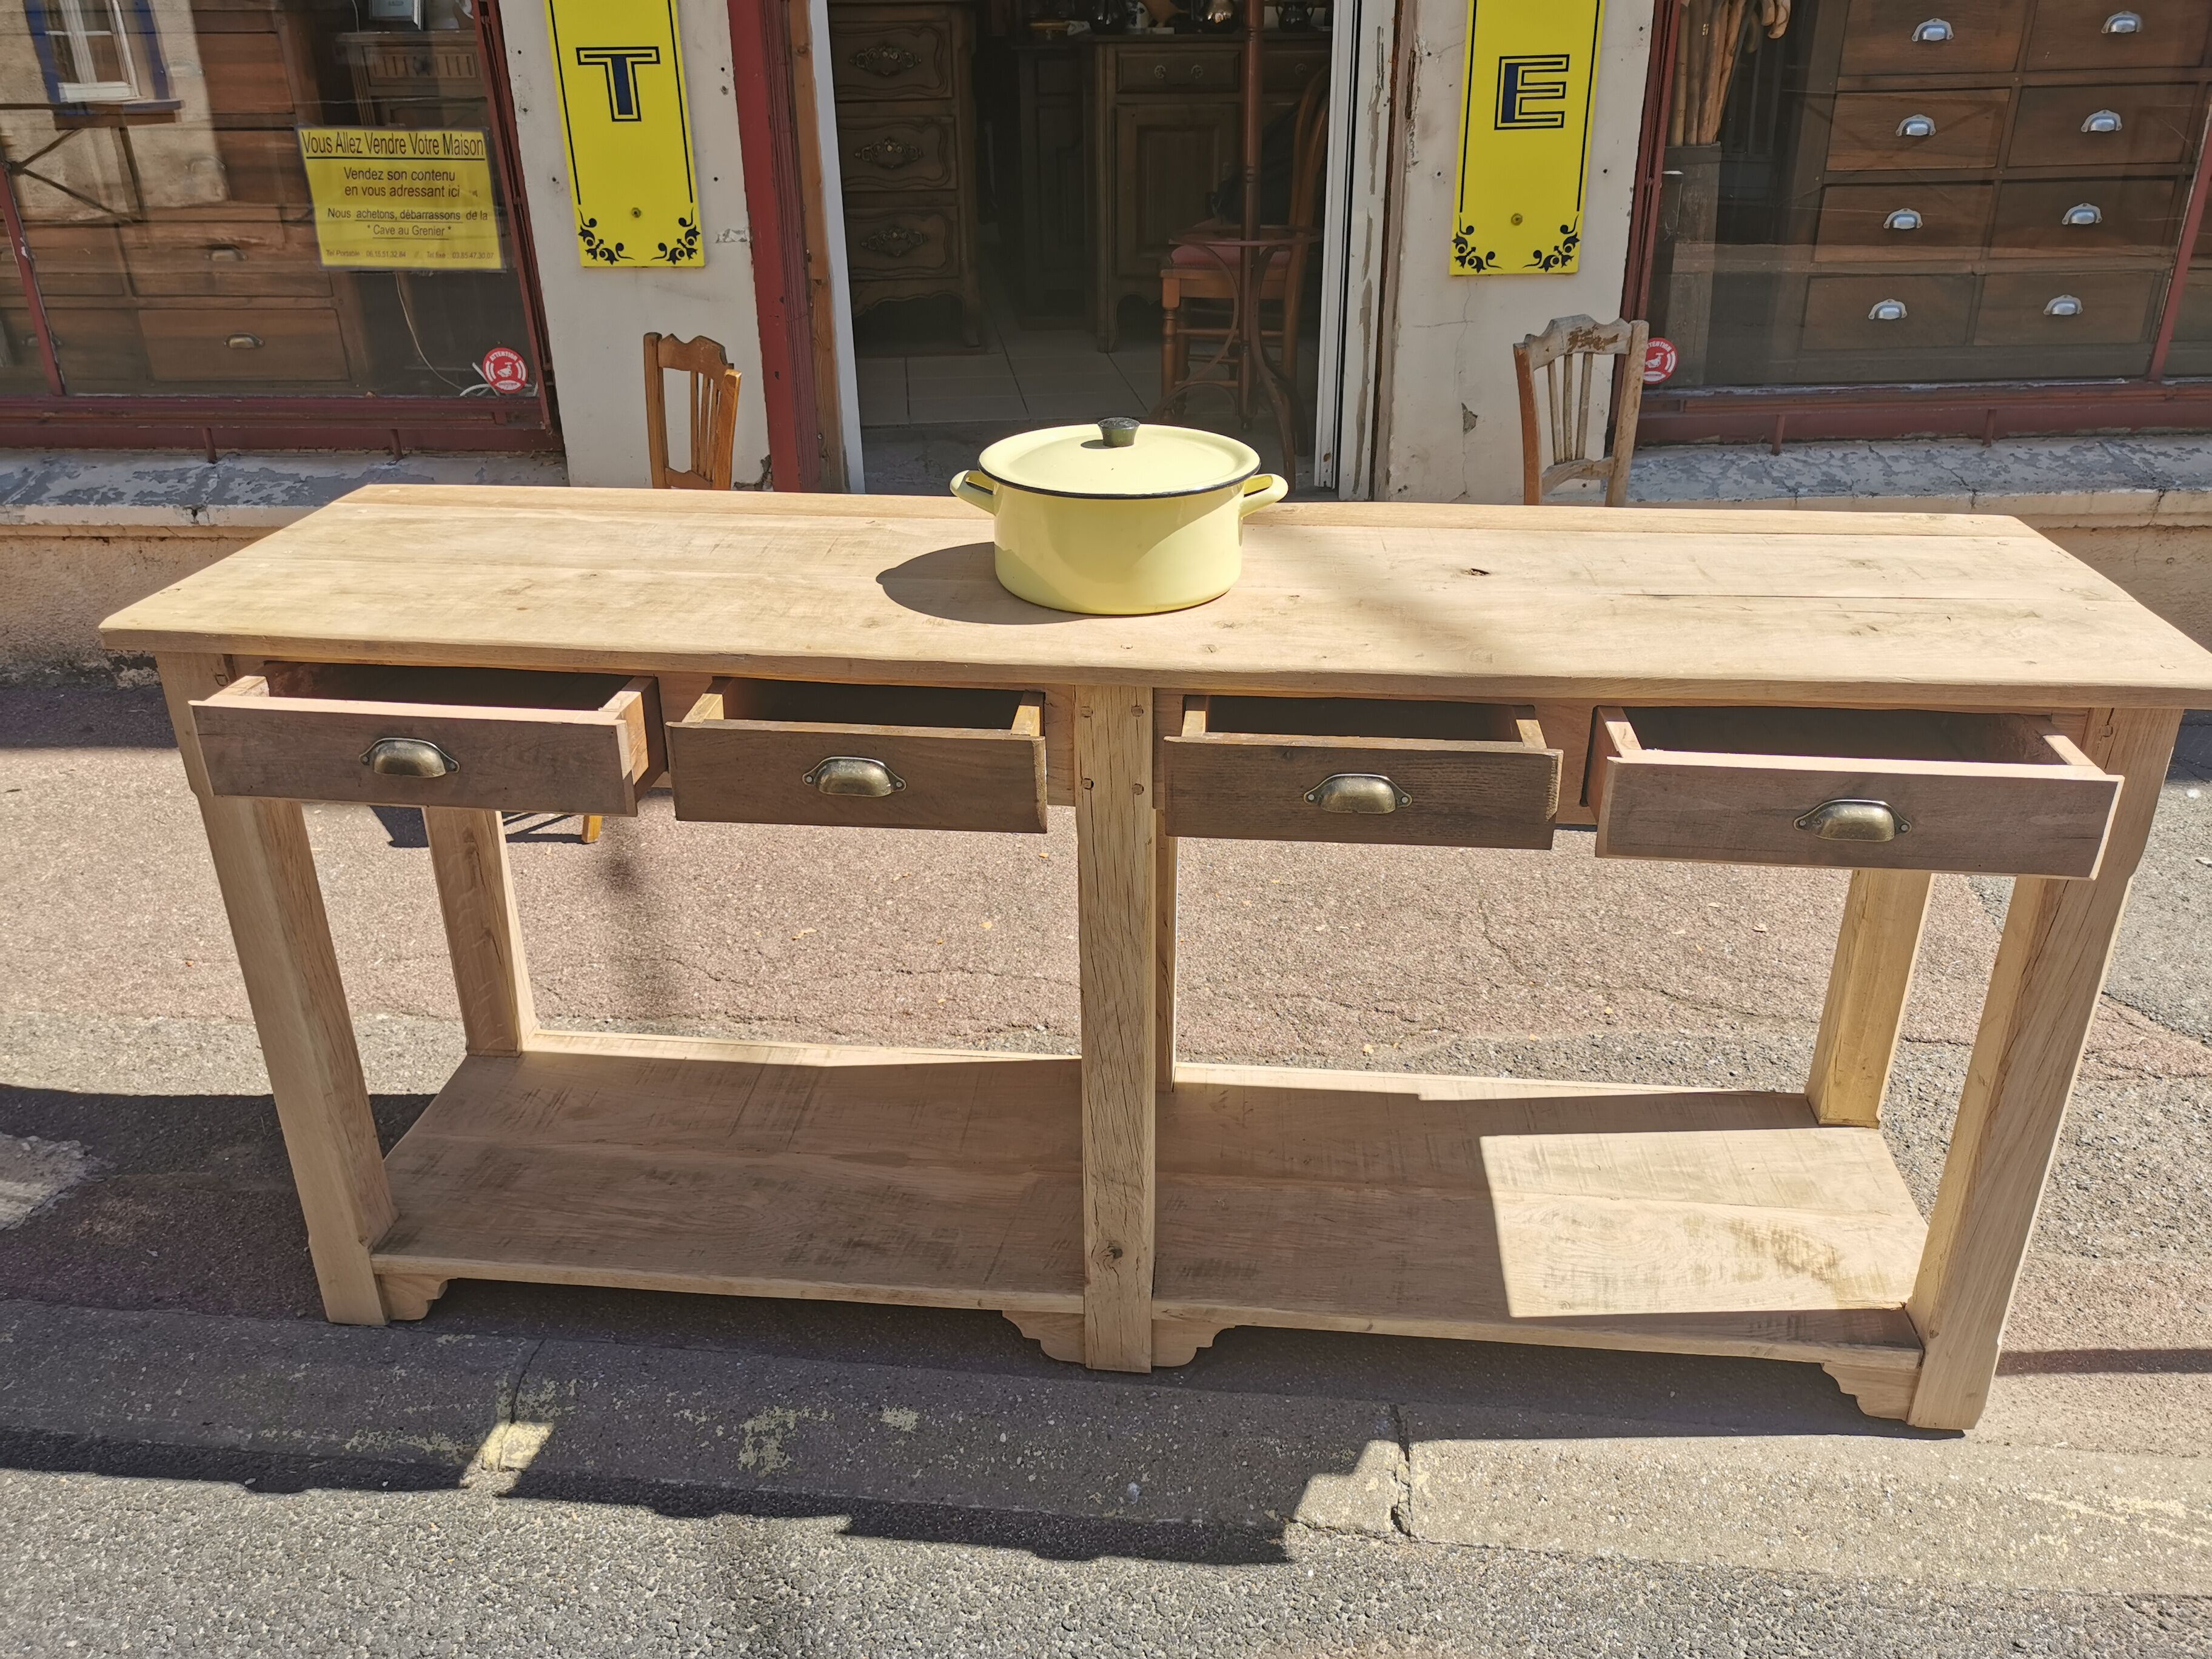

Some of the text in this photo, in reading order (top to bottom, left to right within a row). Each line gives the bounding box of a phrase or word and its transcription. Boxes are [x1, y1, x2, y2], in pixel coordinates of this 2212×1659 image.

[575, 46, 661, 122] T
[1494, 54, 1570, 130] E
[301, 131, 483, 156] Vous Allez Vendre Votre Maison
[343, 167, 455, 181] Vendez son contenu
[344, 184, 460, 197] en vous adressant ici
[327, 208, 488, 220] Nous achetons, débarrassons de la
[373, 224, 395, 235] Cave
[412, 225, 444, 236] Grenier
